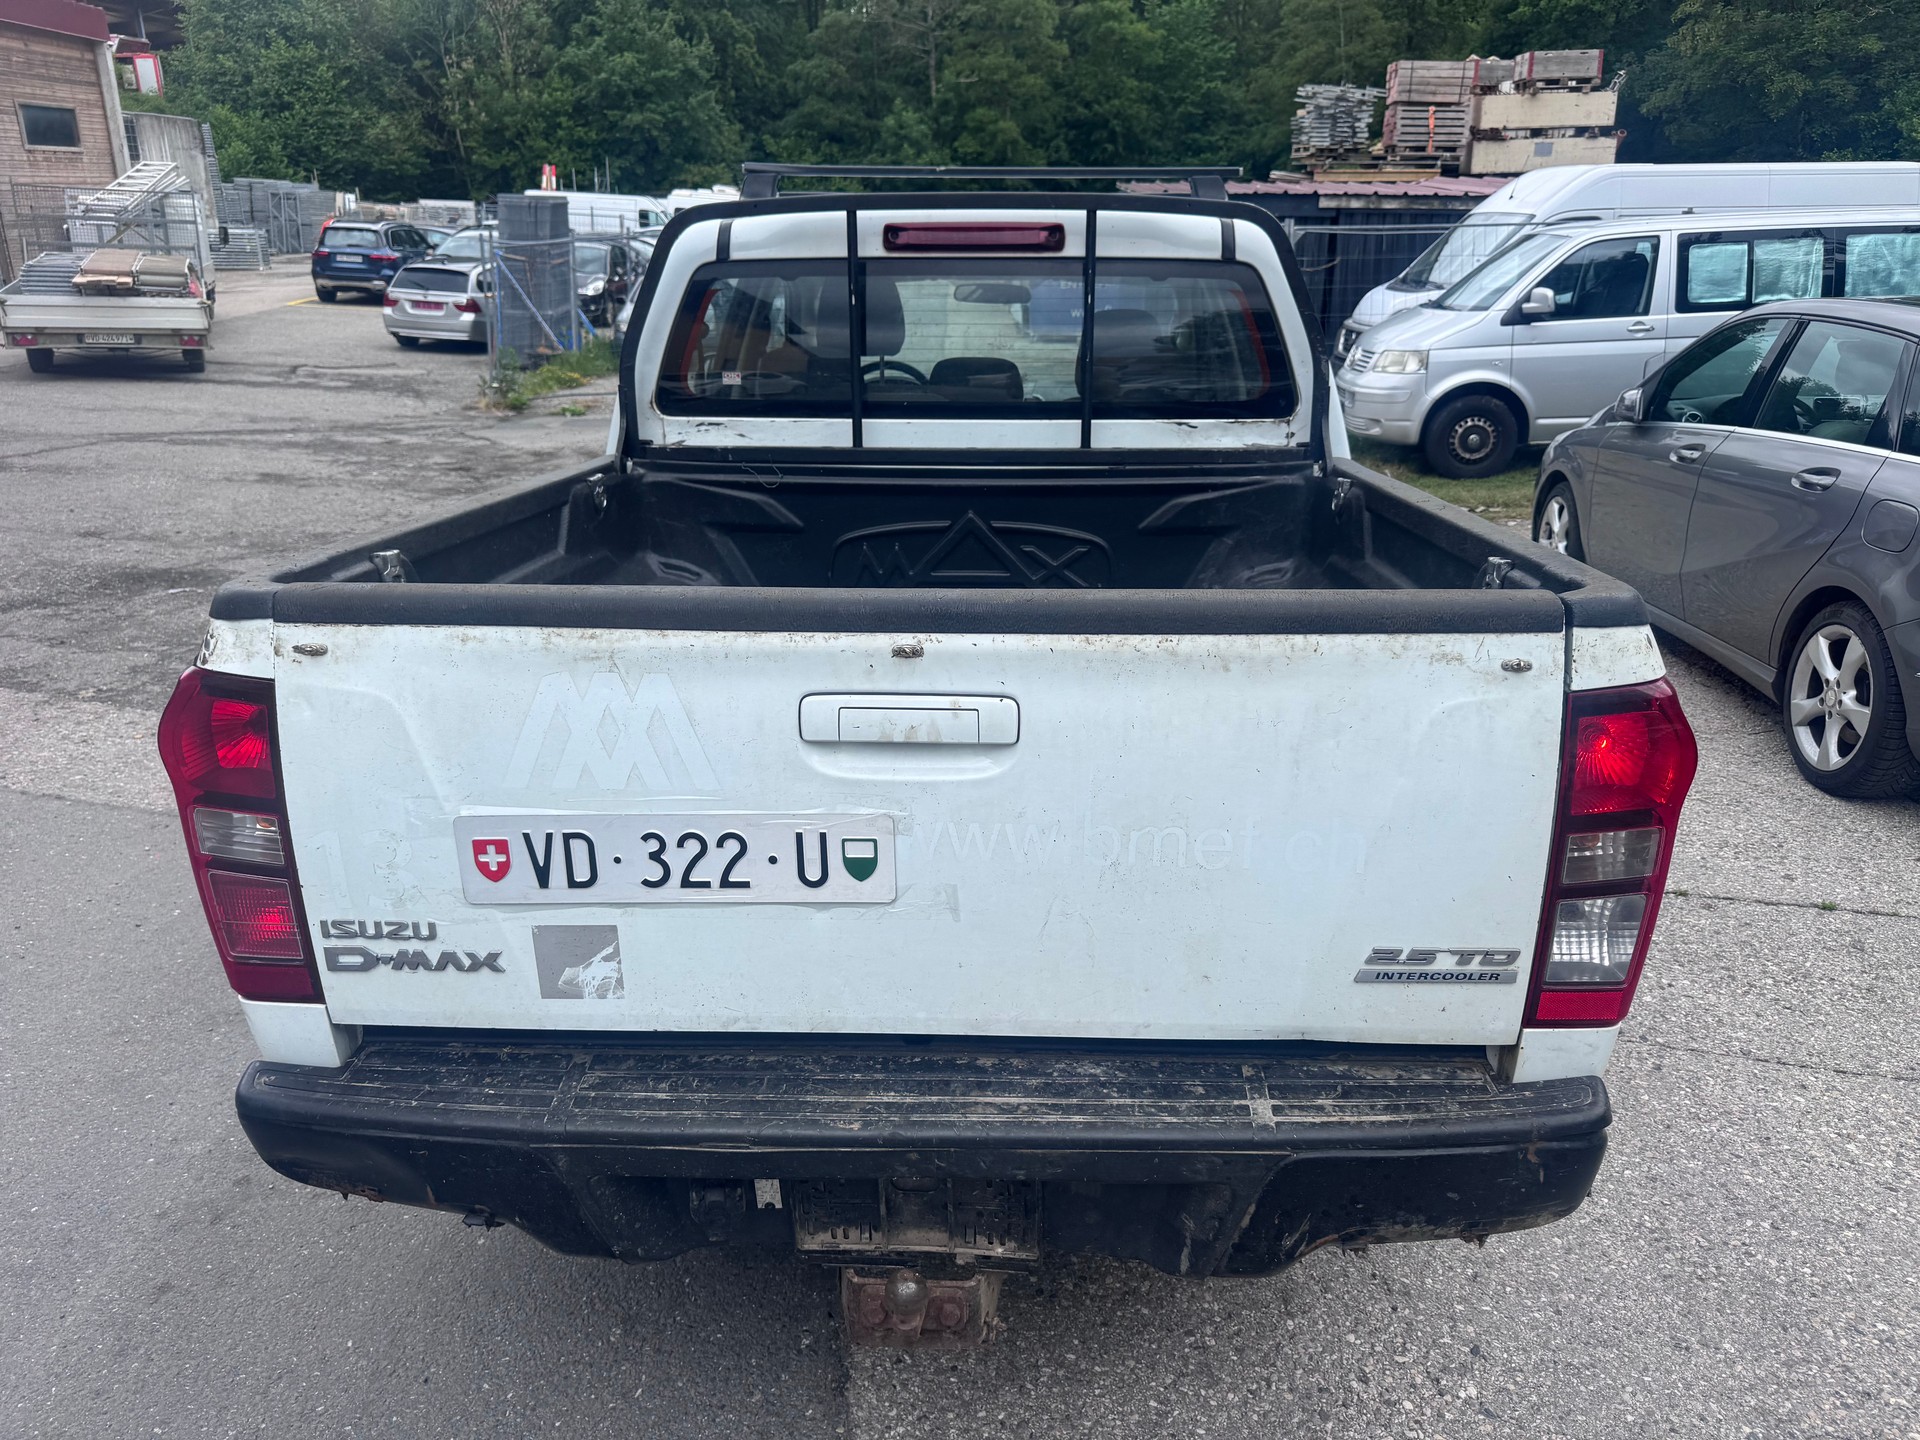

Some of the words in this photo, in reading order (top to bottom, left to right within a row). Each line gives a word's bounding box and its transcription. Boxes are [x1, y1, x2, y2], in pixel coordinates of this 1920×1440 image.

[319, 919, 438, 941] ISUZU
[322, 944, 507, 974] D-MAX
[1374, 971, 1501, 982] INTERCOOLER
